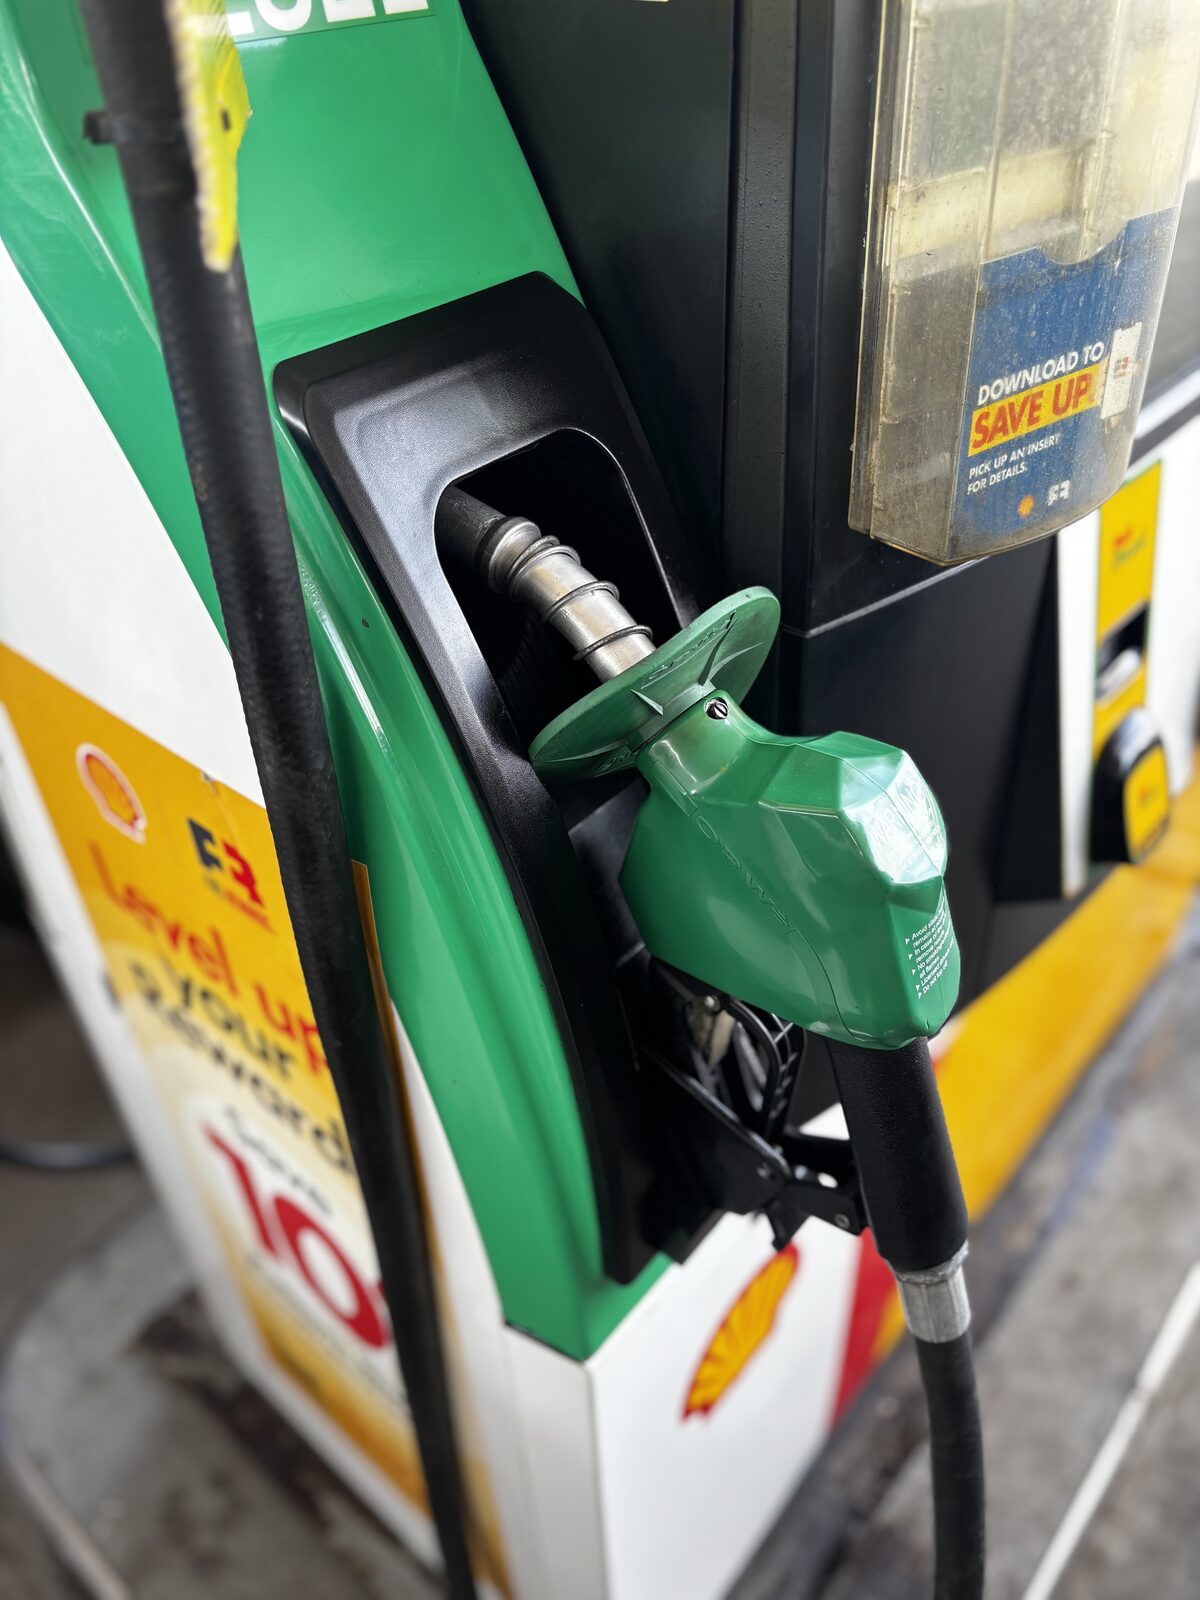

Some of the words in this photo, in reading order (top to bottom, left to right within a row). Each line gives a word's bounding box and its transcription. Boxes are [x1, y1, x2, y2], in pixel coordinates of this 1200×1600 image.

[977, 350, 1078, 406] DOWNLOAD
[1083, 341, 1105, 365] TO
[972, 389, 1043, 449] SAVE
[969, 460, 992, 479] PICK
[993, 454, 1008, 469] UP
[1009, 447, 1026, 463] AN
[1027, 433, 1061, 455] INSERT
[966, 479, 987, 496] FOR
[912, 925, 927, 940] Avoid
